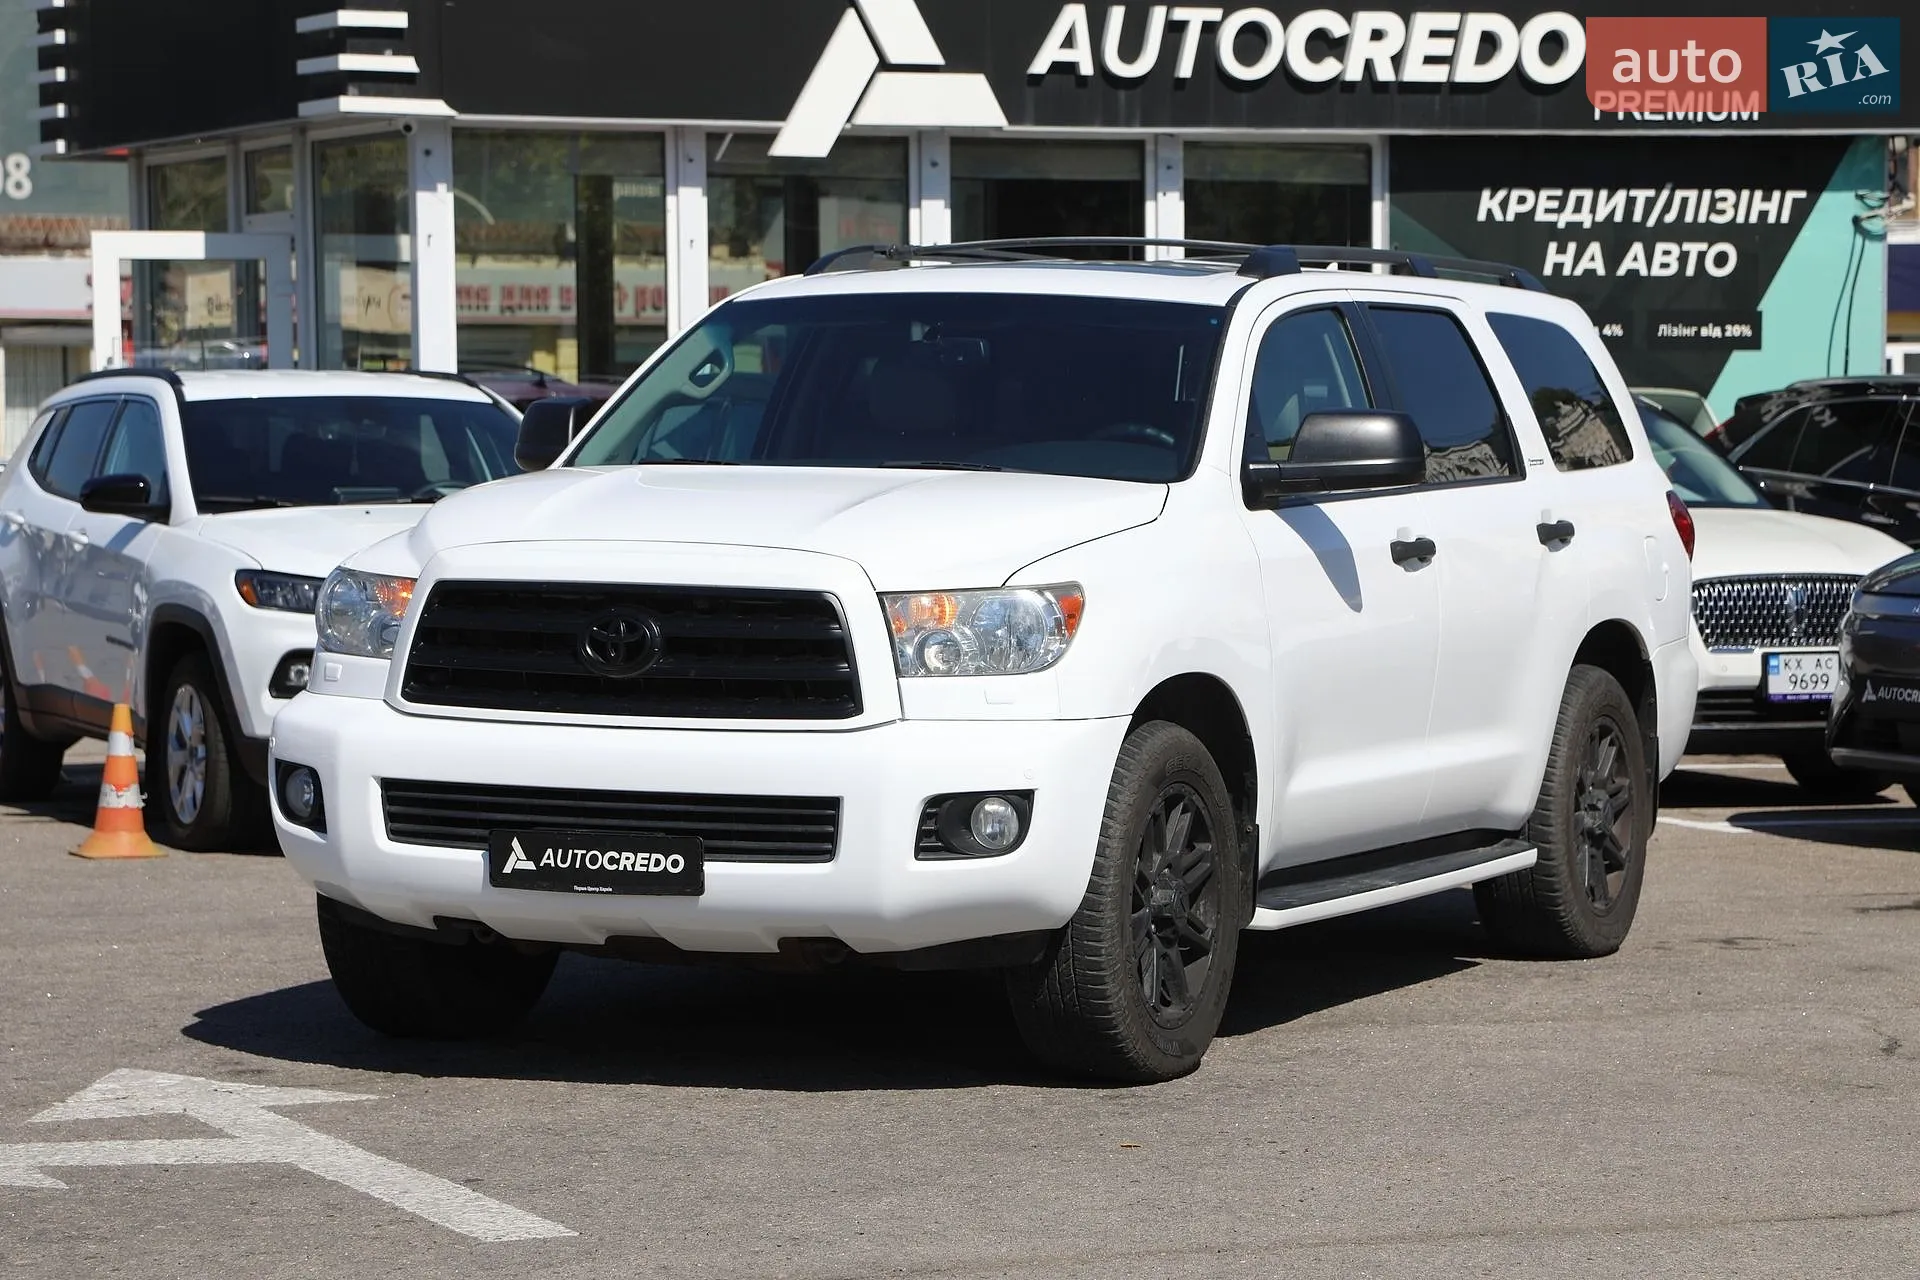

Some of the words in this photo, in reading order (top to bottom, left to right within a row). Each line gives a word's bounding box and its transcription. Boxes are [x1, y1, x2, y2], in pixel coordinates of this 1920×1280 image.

[1027, 2, 1587, 86] AUTOCREDO
[1593, 89, 1760, 122] PREMIUM
[1476, 183, 1807, 229] КРЕДИТ/ЛІЗІНГ
[1542, 240, 1607, 277] НА
[1615, 240, 1738, 278] АВТО
[1601, 323, 1624, 337] 4%
[1657, 323, 1698, 337] Лізінг
[1700, 322, 1722, 338] від
[1724, 324, 1752, 338] 20%
[1788, 673, 1830, 691] 9699
[539, 848, 685, 874] AUTOCREDO
